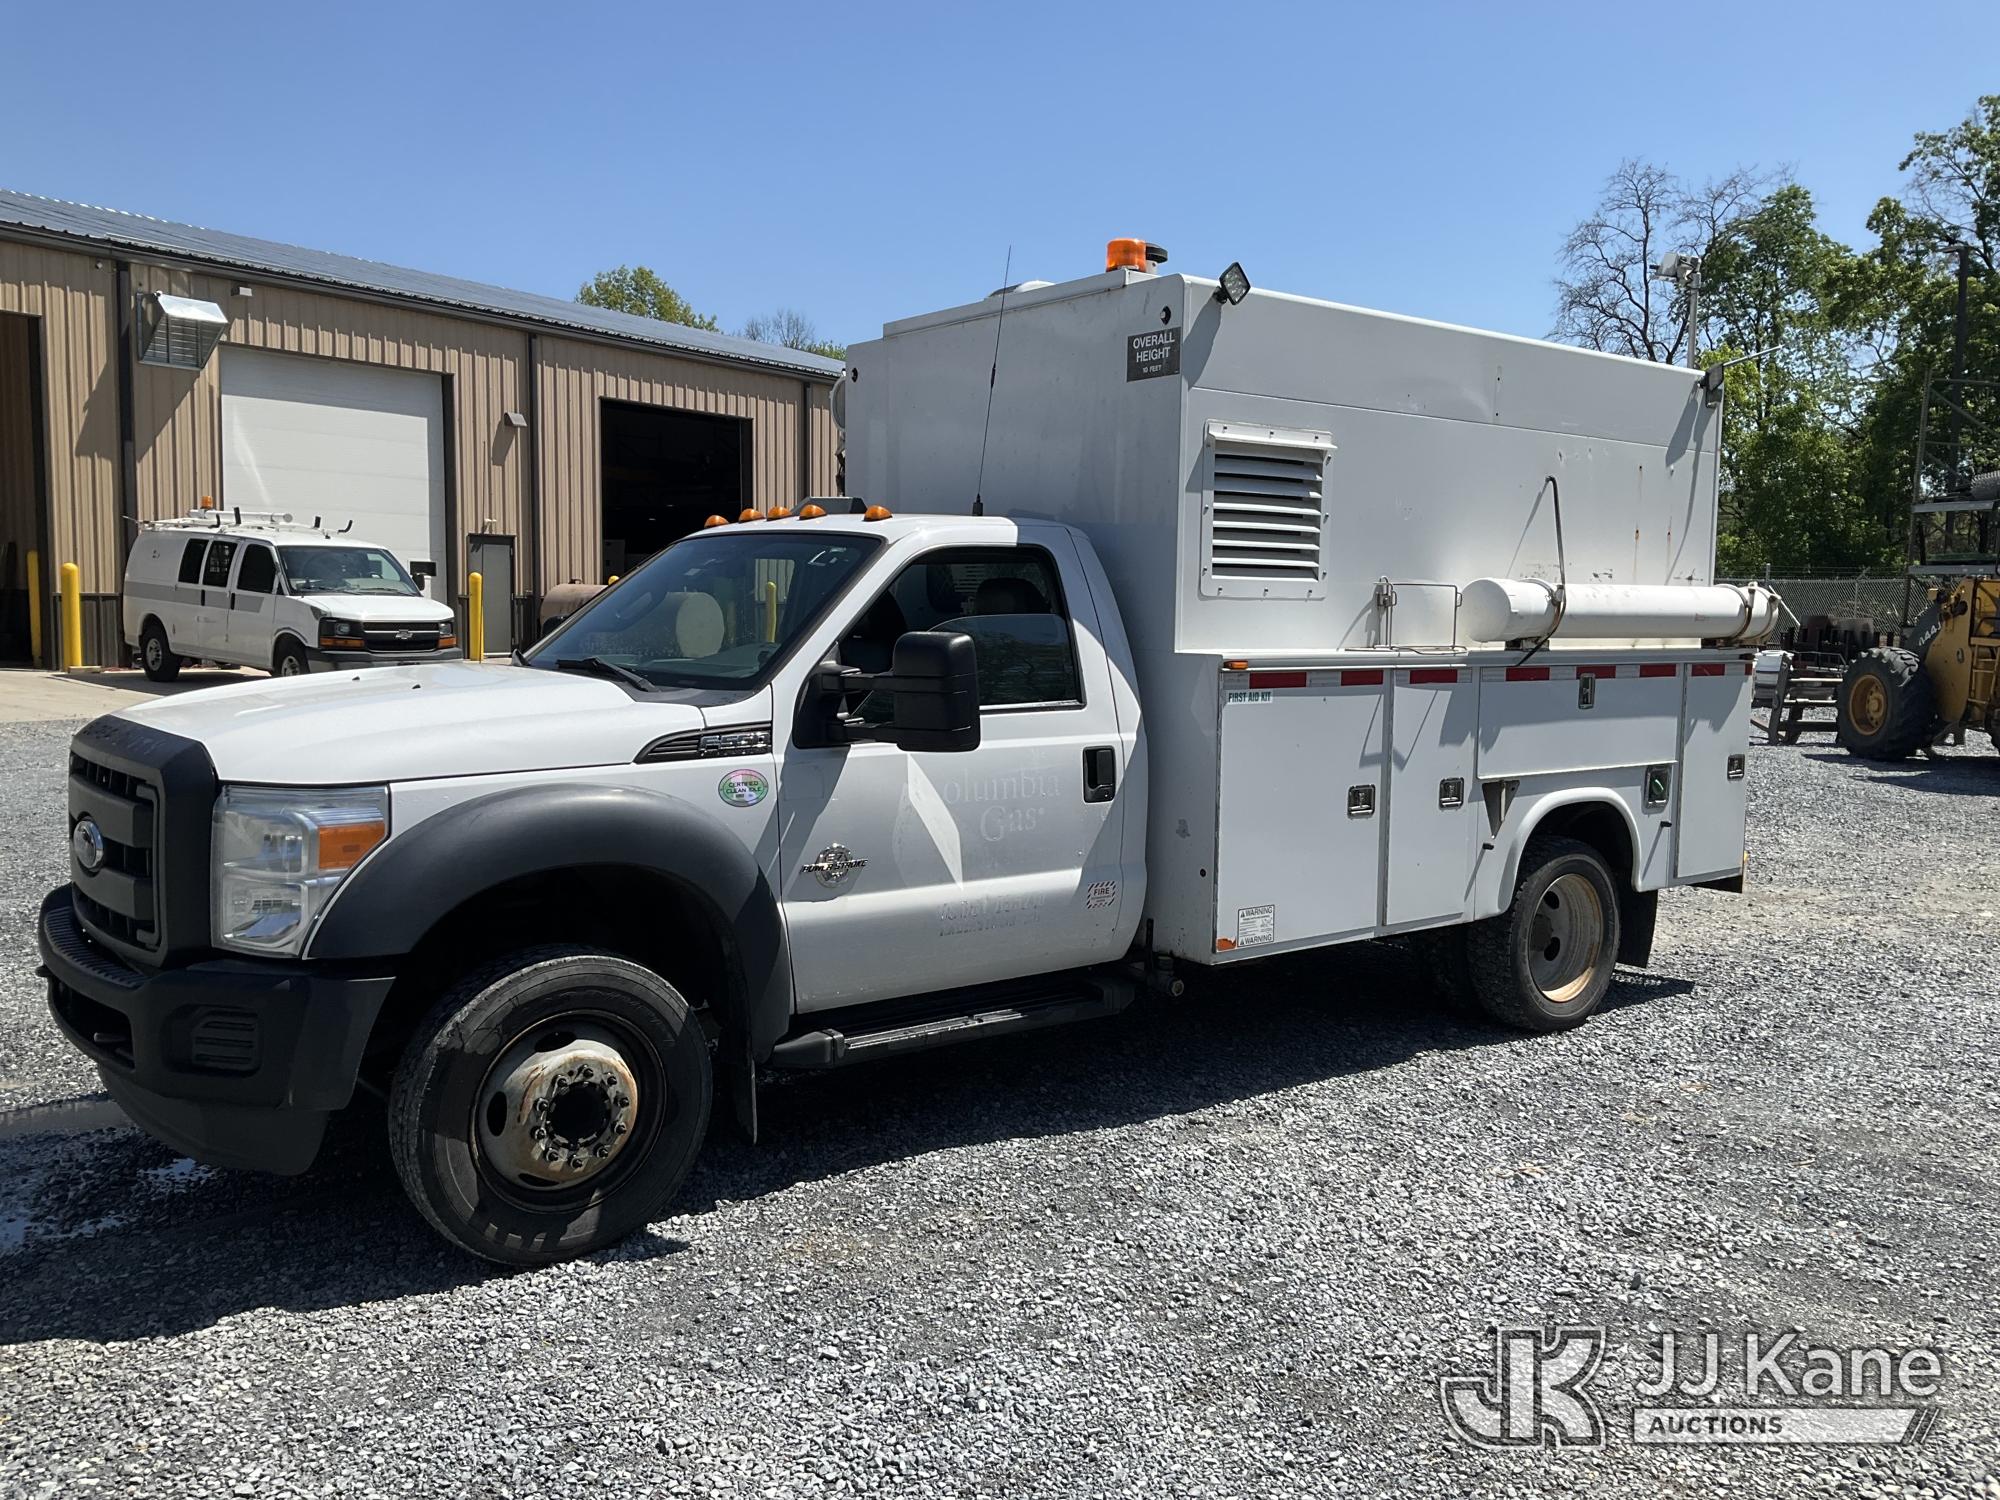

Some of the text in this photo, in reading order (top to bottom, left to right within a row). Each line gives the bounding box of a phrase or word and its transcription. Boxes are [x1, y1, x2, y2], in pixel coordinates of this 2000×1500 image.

[1132, 332, 1175, 349] OVERALL
[1136, 347, 1171, 363] HEIGHT
[1149, 364, 1162, 373] FEET
[1228, 691, 1272, 703] FIRST AID KIT
[1093, 887, 1110, 896] FIRE
[1245, 906, 1273, 917] WARNING
[1244, 933, 1273, 945] WARNING
